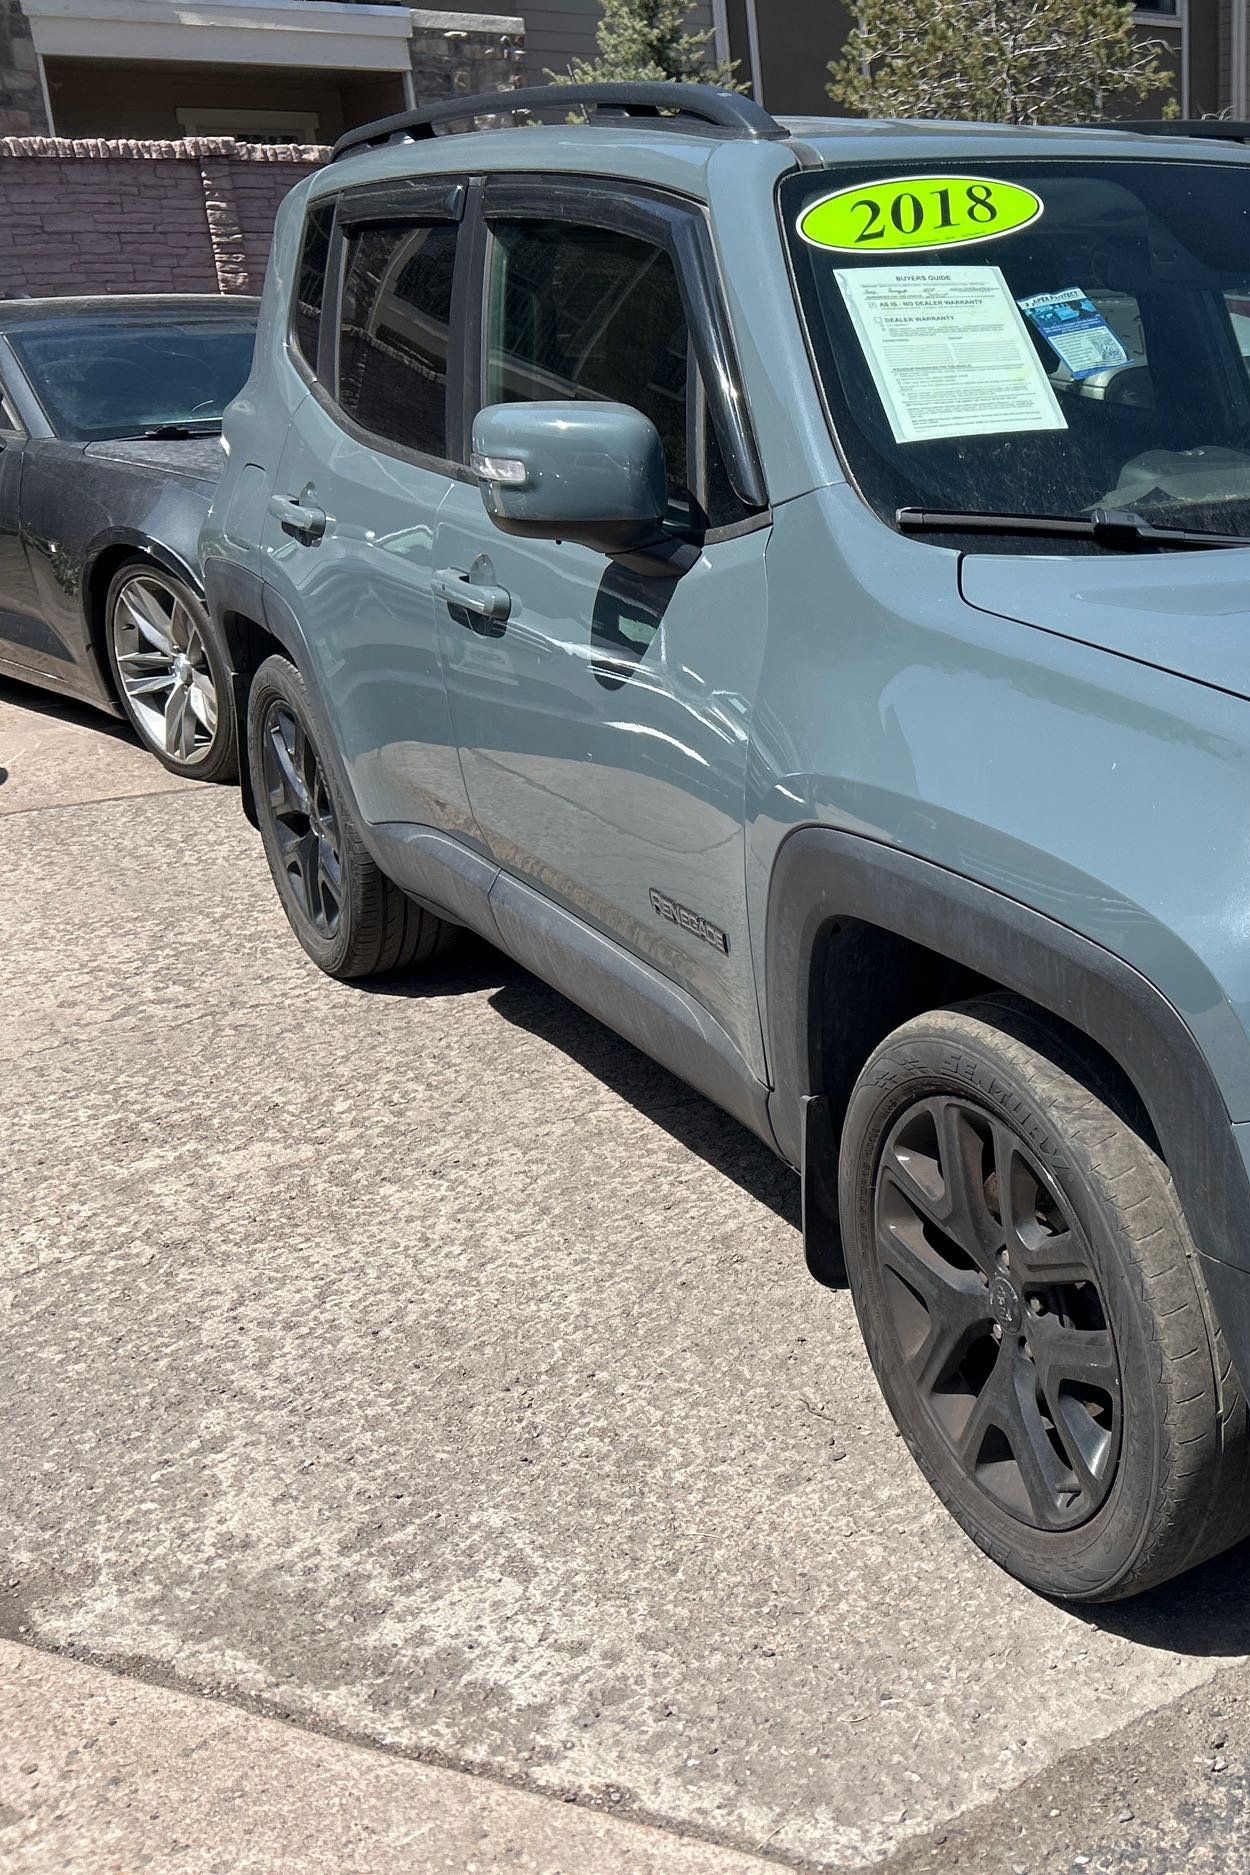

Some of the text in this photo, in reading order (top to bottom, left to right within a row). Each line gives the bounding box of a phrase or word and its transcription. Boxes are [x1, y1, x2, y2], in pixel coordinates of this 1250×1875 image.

[850, 185, 998, 243] 2018
[914, 299, 943, 307] DEALER
[943, 298, 983, 306] WARRANTY
[884, 315, 955, 324] DEALER WARRANTY
[648, 888, 730, 957] RENEGADE
